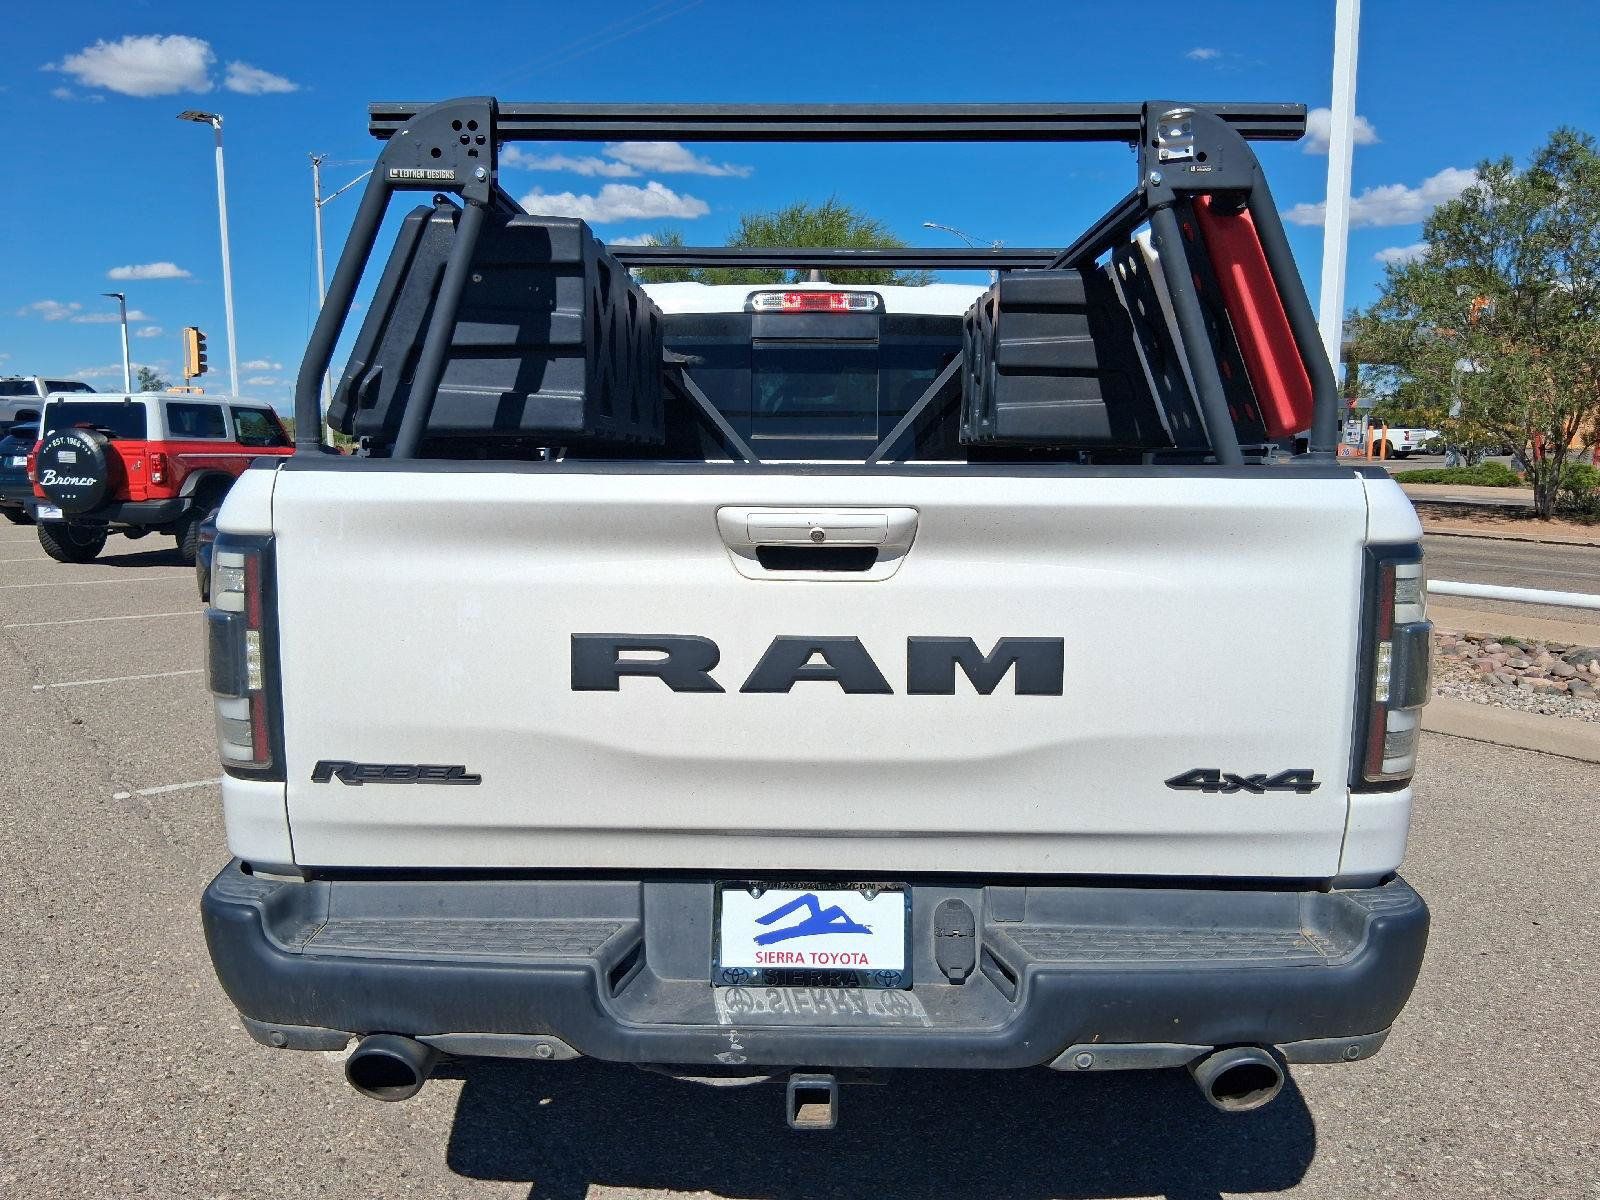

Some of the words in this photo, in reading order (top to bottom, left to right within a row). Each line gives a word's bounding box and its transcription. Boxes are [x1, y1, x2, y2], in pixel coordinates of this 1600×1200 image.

[399, 169, 425, 179] LEITNER
[426, 169, 455, 180] DESIGNS
[66, 436, 82, 448] 1966
[40, 469, 98, 486] Bronco
[571, 633, 1064, 696] RAM
[311, 760, 482, 786] REBEL
[755, 951, 805, 964] SIERRA
[809, 952, 869, 965] TOYOTA
[764, 969, 861, 987] SIERRA
